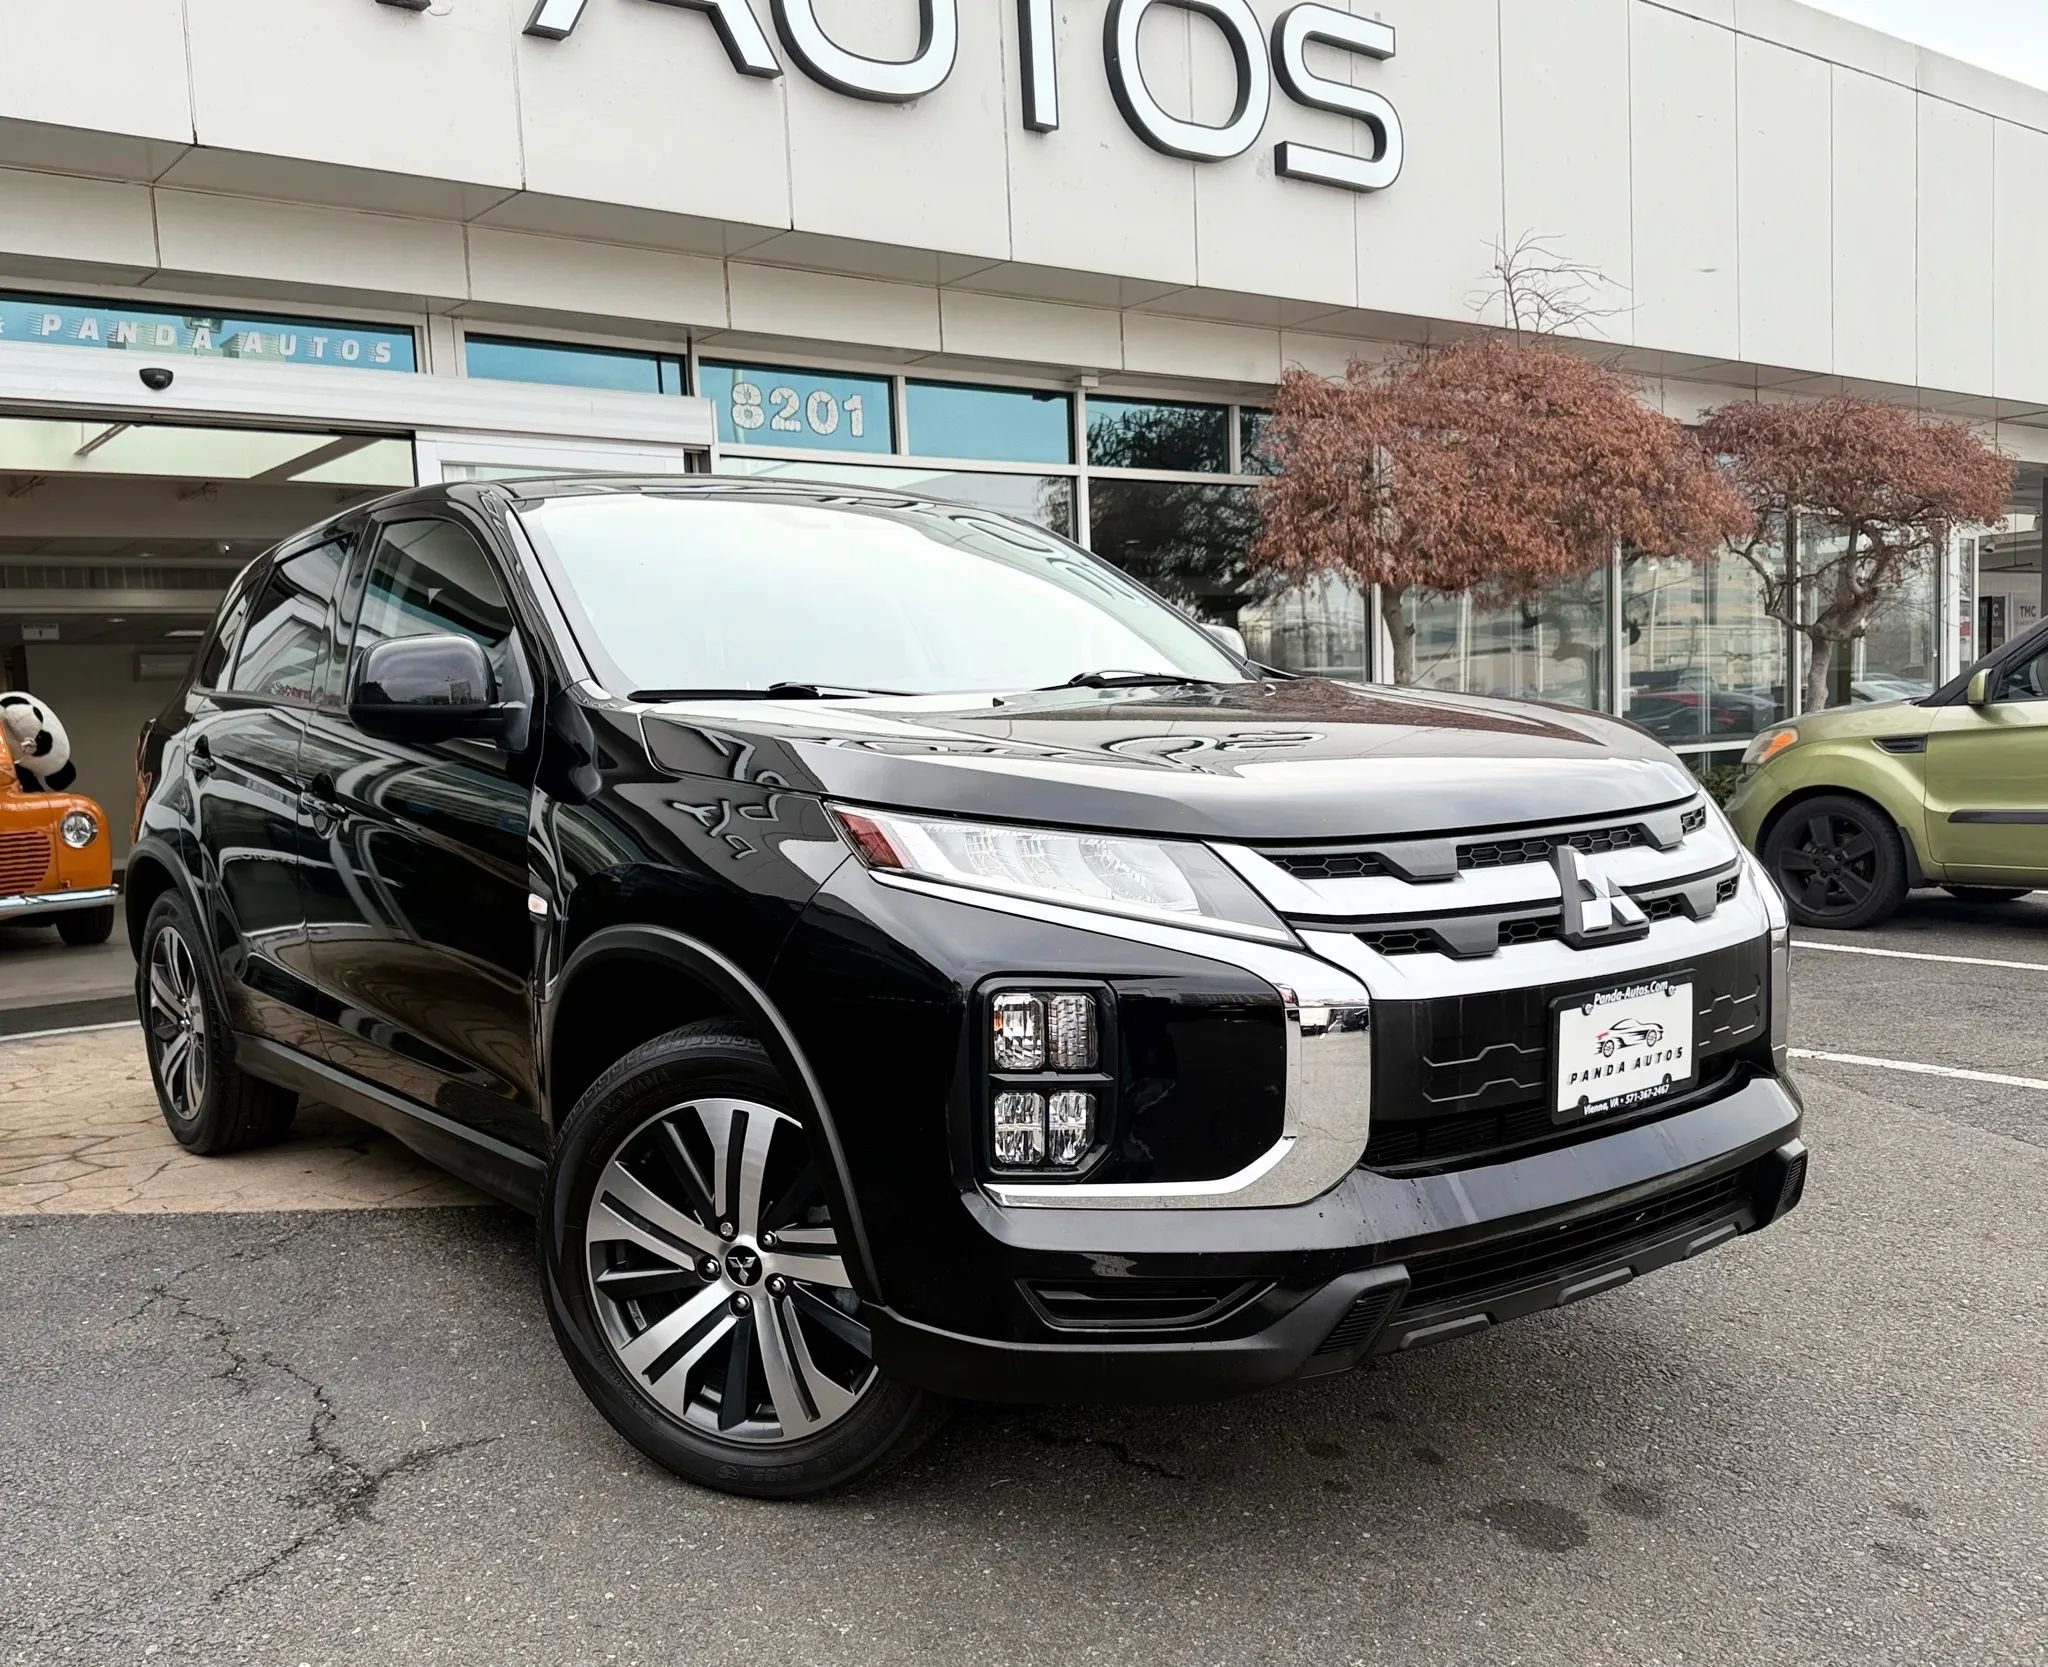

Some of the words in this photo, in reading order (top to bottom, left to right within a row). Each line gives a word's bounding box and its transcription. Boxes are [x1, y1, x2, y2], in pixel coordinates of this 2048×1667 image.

[41, 312, 212, 350] PANDA
[243, 331, 392, 364] AUTOS
[731, 383, 864, 438] 8201
[2019, 605, 2037, 618] TMC
[1594, 981, 1668, 1005] Panda-Autos.Com
[1570, 1061, 1625, 1085] PANDA
[1634, 1047, 1683, 1069] AUTOS
[1584, 1103, 1609, 1116] Vienna,
[1610, 1097, 1620, 1109] VA
